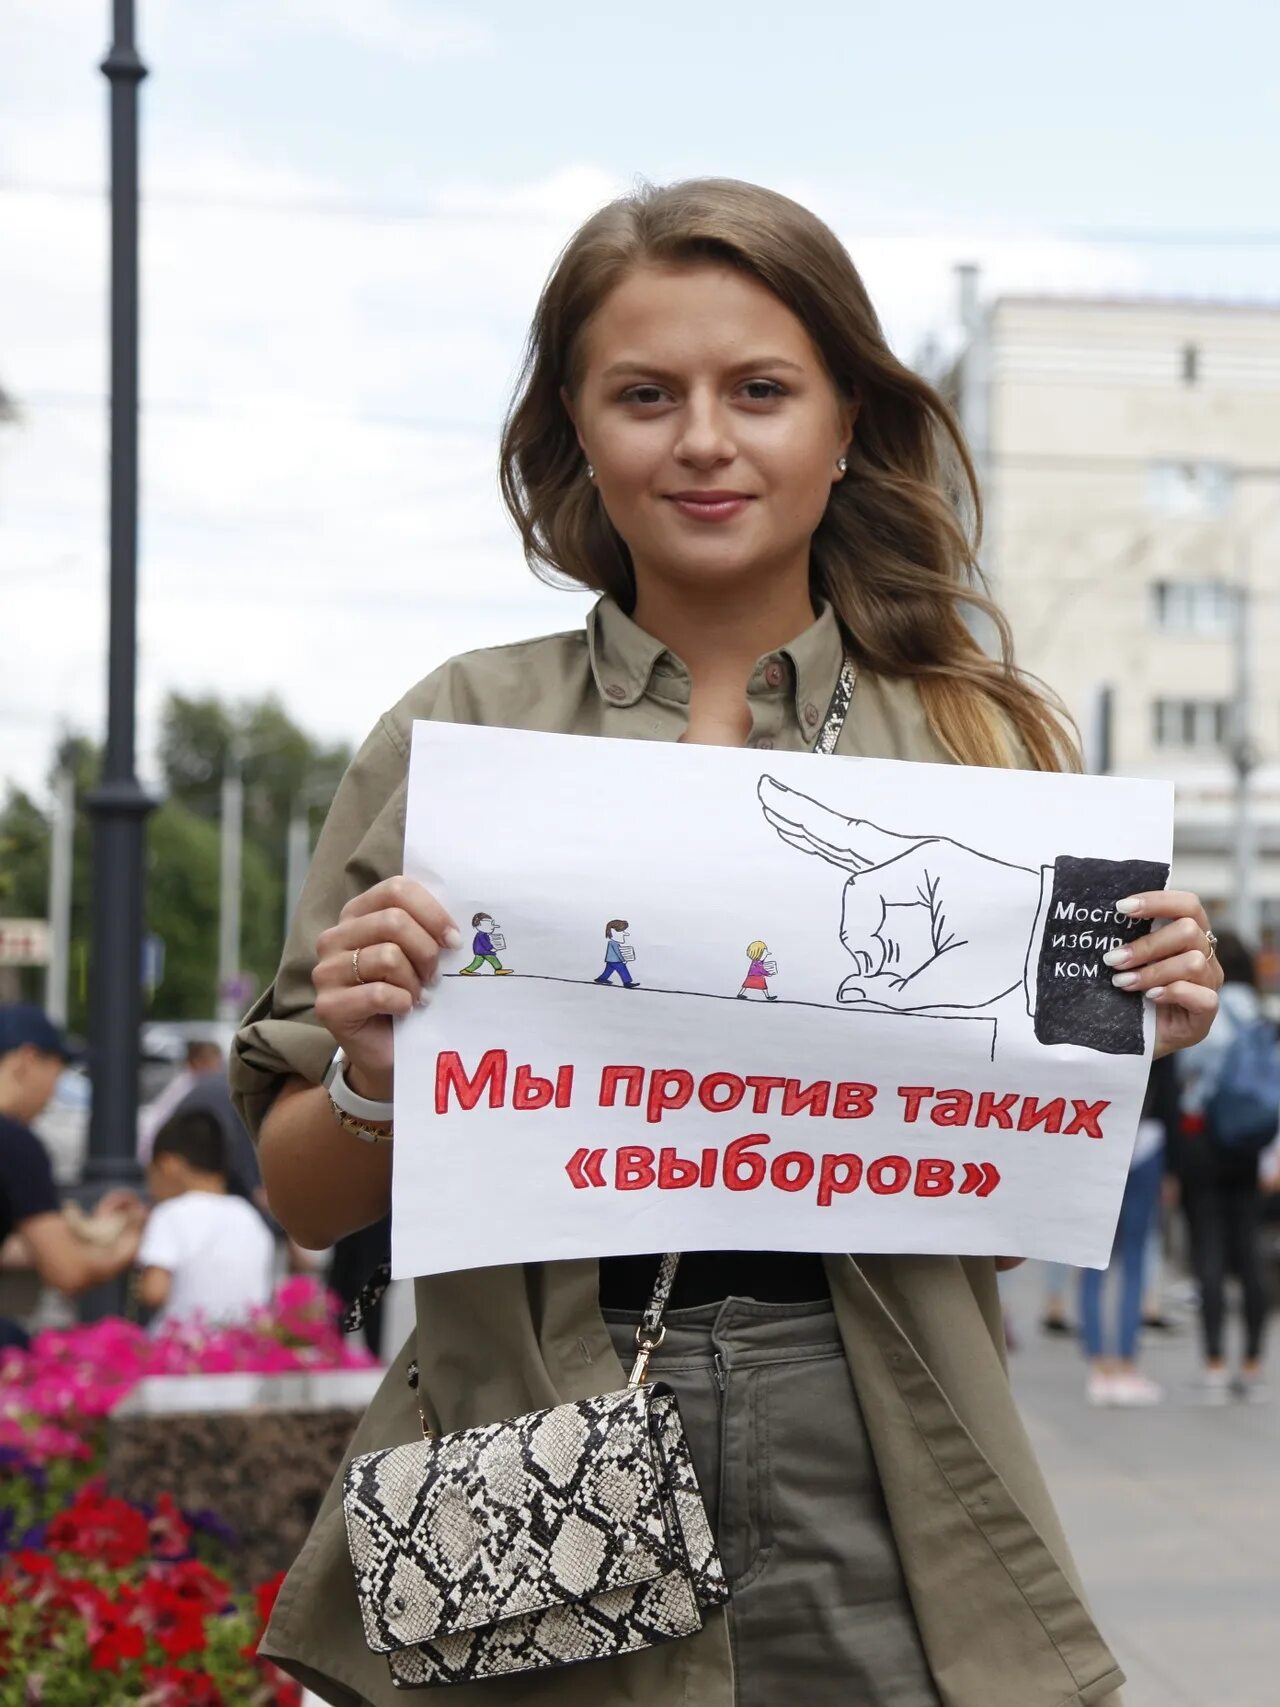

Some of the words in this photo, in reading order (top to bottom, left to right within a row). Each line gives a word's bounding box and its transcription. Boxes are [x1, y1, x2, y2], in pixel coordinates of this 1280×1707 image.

[1054, 961, 1098, 978] ком
[434, 1048, 574, 1115] Мы
[598, 1064, 878, 1124] против
[897, 1085, 1111, 1139] таких
[564, 1133, 1002, 1207] «выборов»
